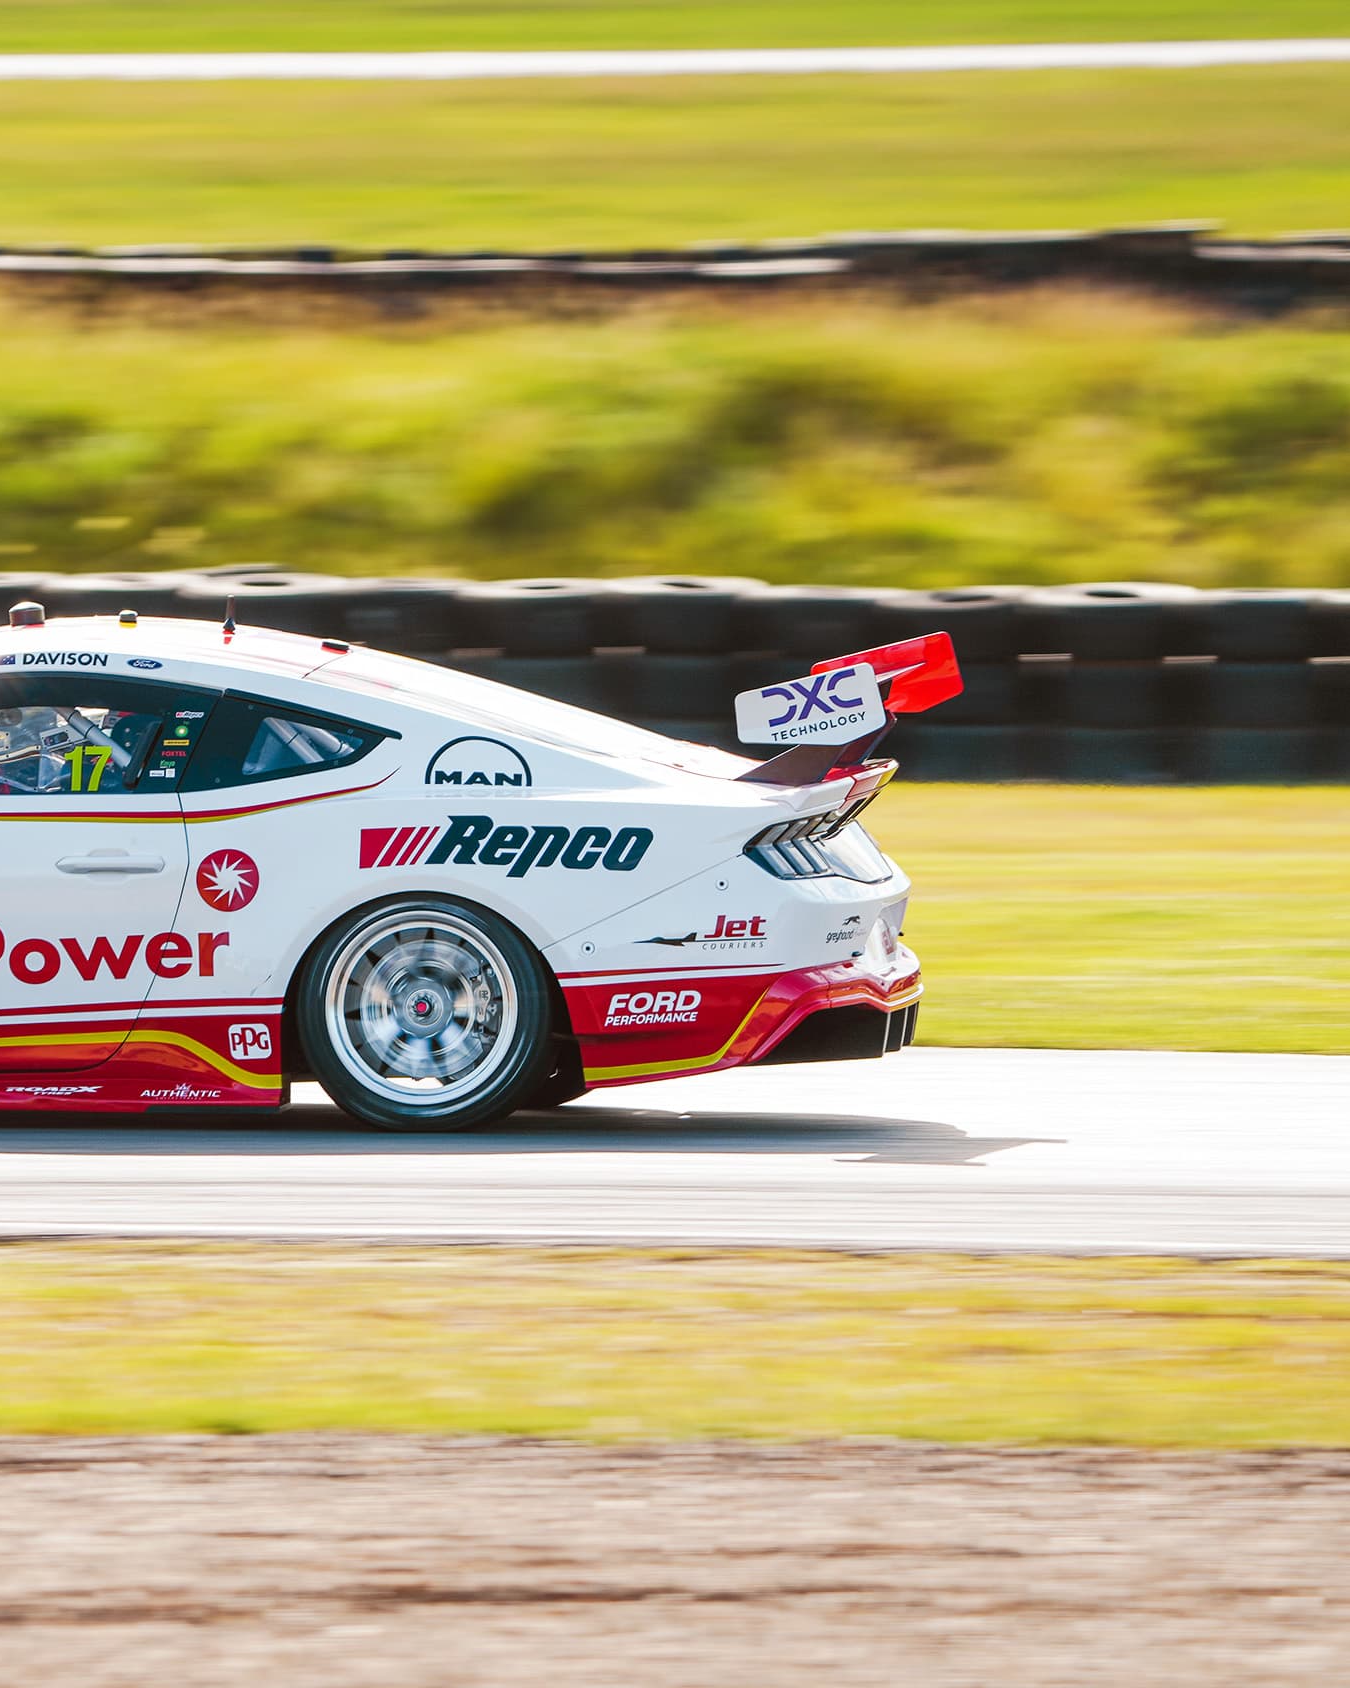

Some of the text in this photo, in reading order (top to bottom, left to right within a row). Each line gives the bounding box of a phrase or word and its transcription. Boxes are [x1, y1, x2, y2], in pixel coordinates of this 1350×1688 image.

[22, 653, 109, 666] DAVISON
[761, 668, 864, 727] DXC
[771, 711, 866, 741] TECHNOLOGY
[64, 745, 112, 792] 17
[434, 770, 523, 786] MAN
[424, 815, 654, 878] Repco
[703, 915, 767, 939] Jet
[701, 941, 765, 950] COURIERS
[607, 989, 702, 1015] FORD
[604, 1011, 699, 1027] PERFORMANCE
[230, 1027, 269, 1056] PPG
[6, 1085, 104, 1093] ROADX
[140, 1089, 222, 1098] AUTHENTIC
